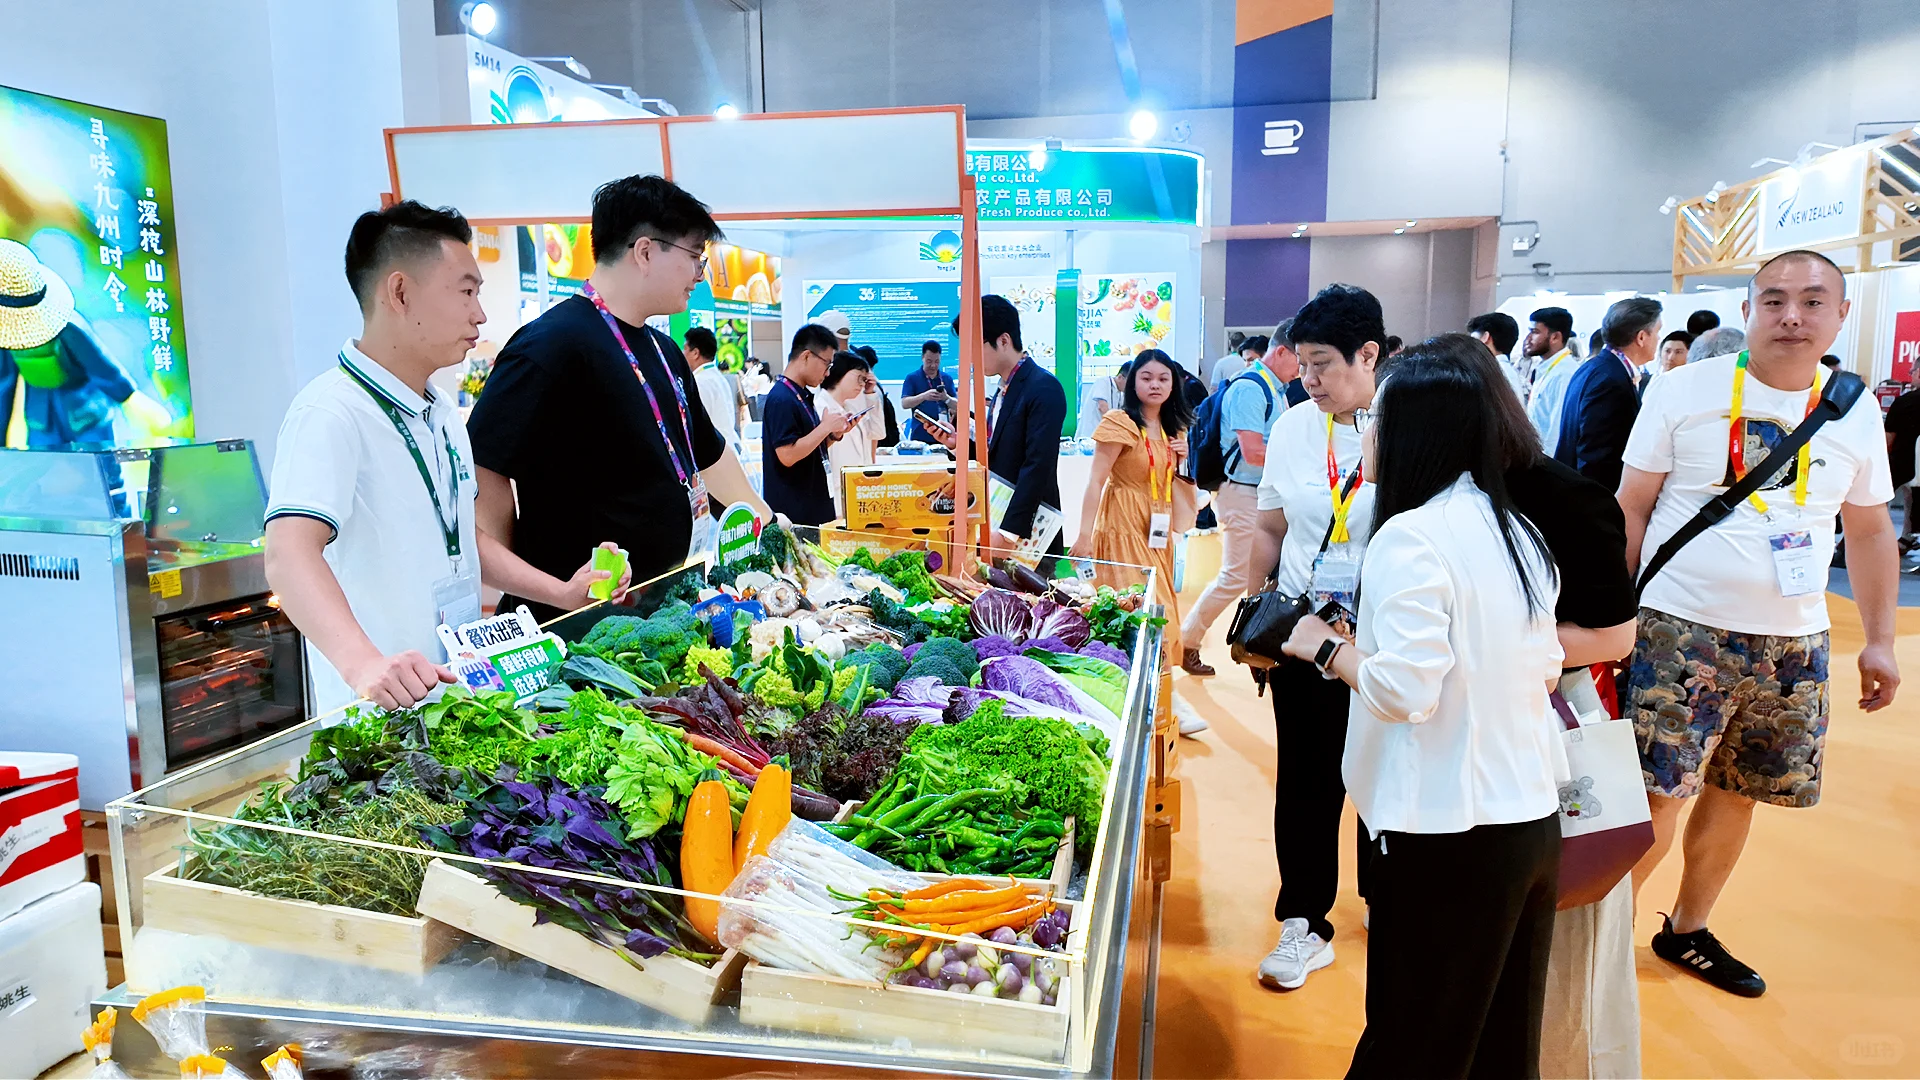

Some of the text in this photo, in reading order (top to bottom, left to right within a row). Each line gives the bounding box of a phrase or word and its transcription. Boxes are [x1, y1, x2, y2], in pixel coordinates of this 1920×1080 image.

[474, 51, 501, 74] 5M14
[991, 172, 1040, 184] co.,Ltd.
[980, 207, 1111, 219] Fresh Produce co.,Ltd.
[1808, 201, 1844, 222] ZEALAND
[856, 484, 886, 492] GOLDEN
[856, 490, 924, 499] SWEET POTATO
[465, 618, 525, 650] 餐饮出海
[498, 644, 550, 676] 臻鲜食材
